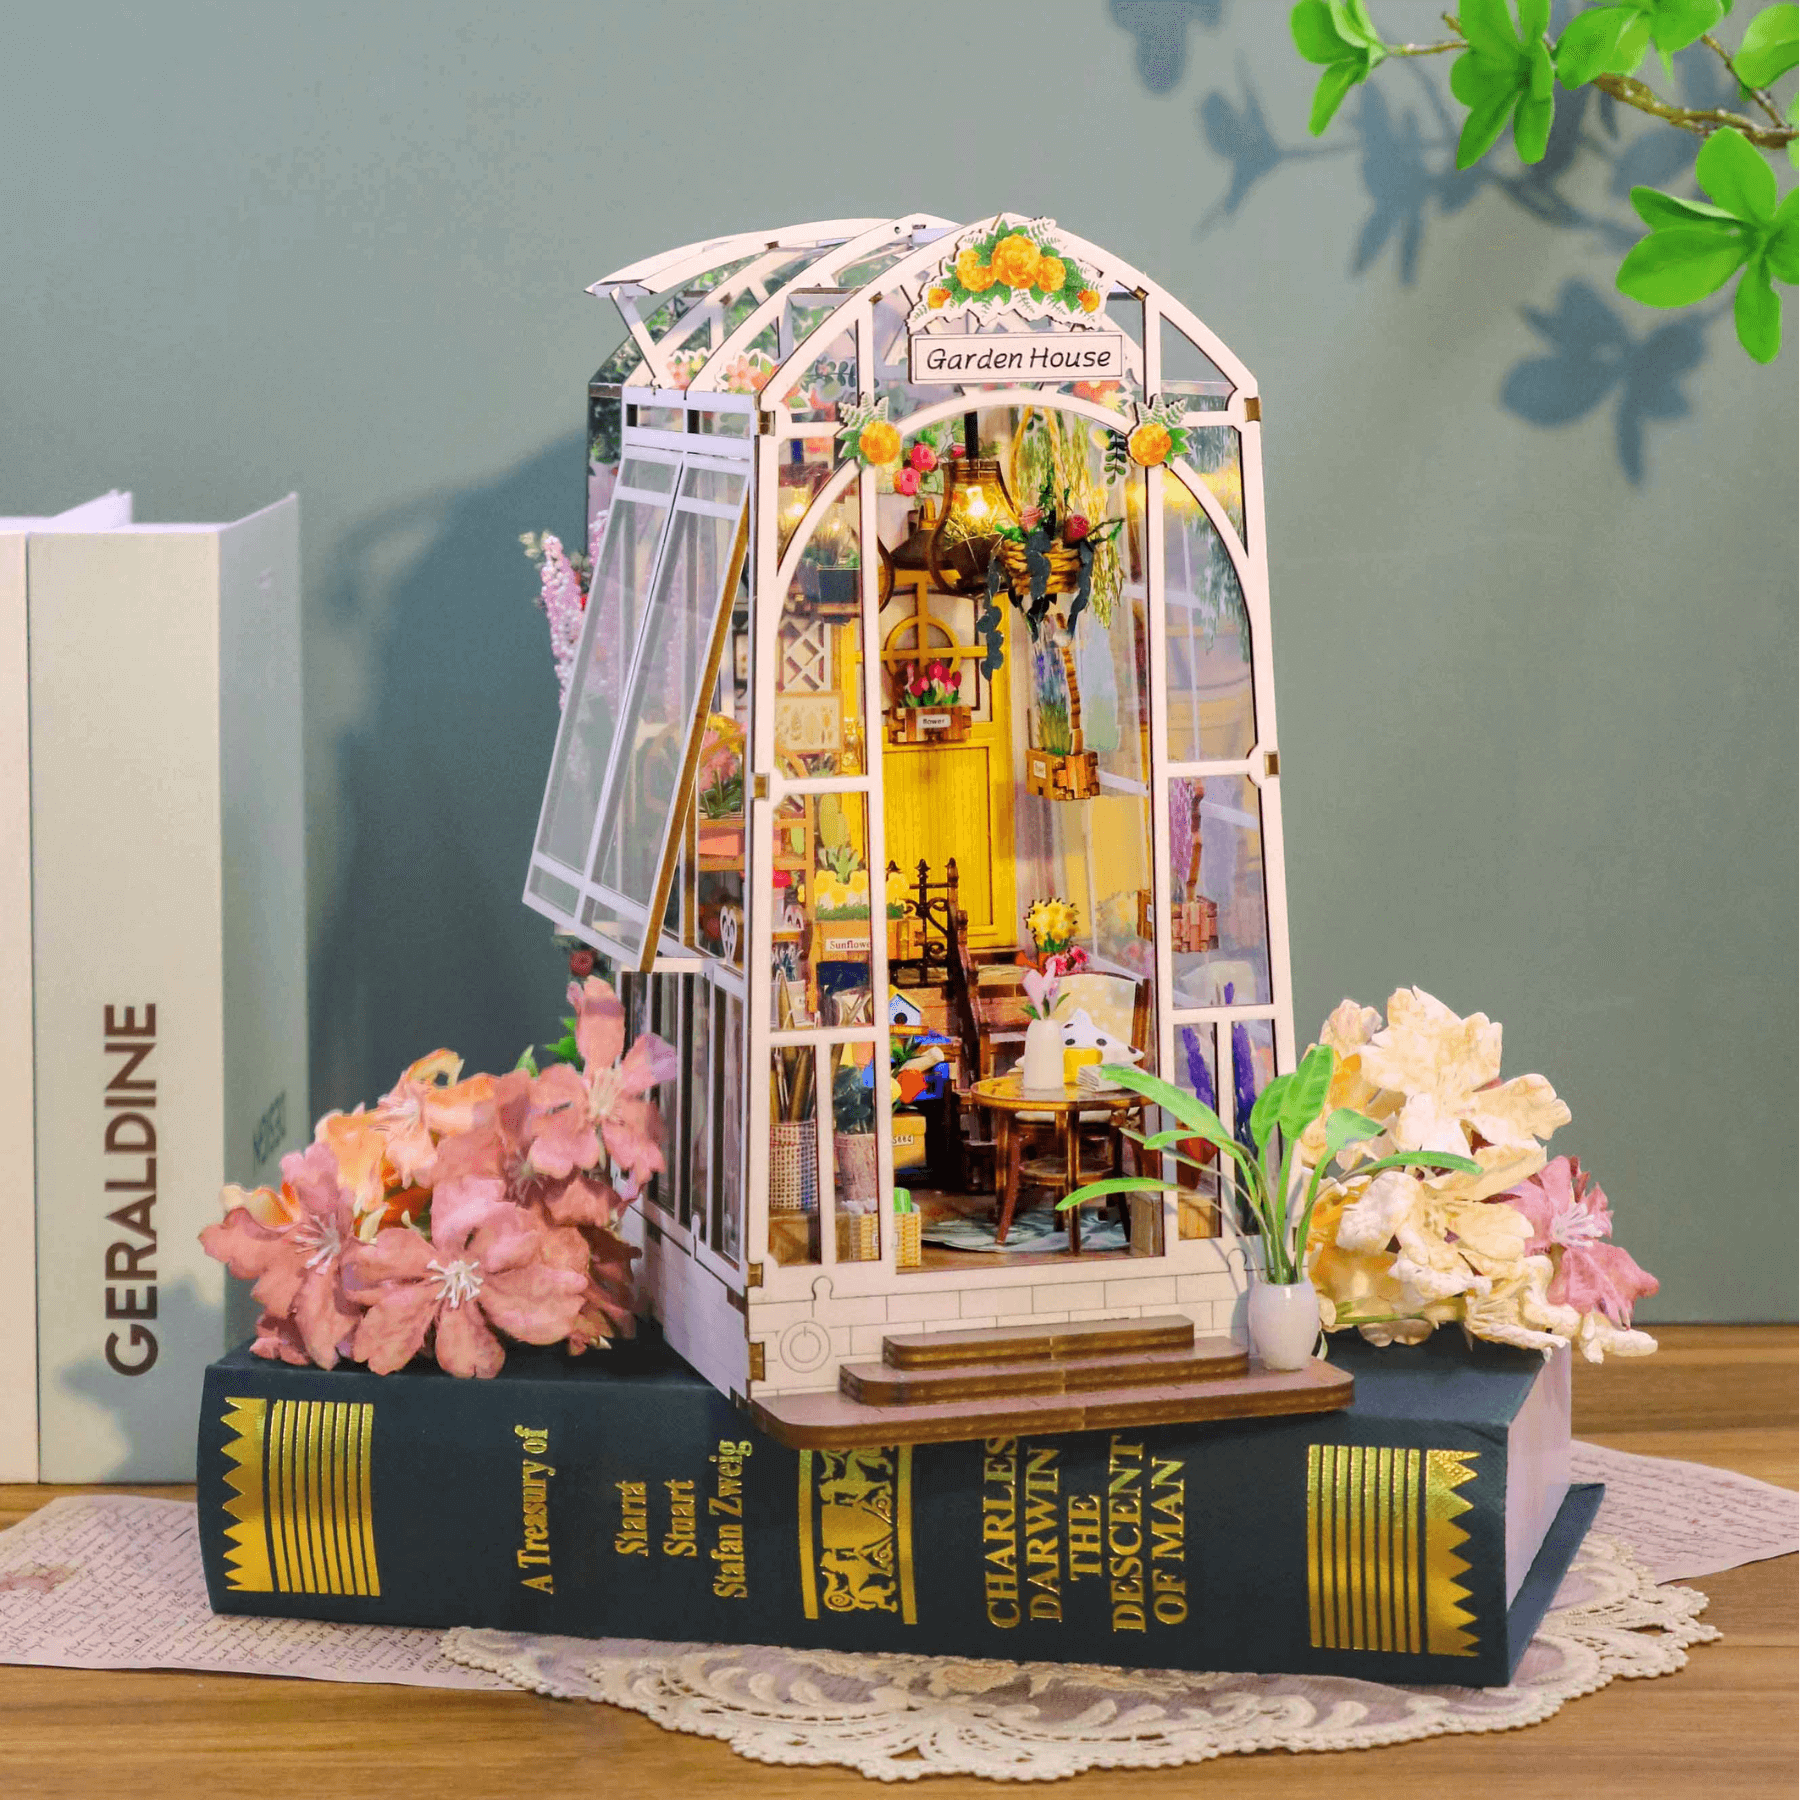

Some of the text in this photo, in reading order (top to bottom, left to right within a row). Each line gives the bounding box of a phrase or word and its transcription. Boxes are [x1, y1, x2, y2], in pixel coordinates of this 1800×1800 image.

[926, 346, 1111, 370] Garden House
[104, 1003, 158, 1377] GERALDINE
[514, 1424, 556, 1595] A Treasury of
[663, 1479, 697, 1557] Stuart
[708, 1440, 752, 1599] Stafan Zweig
[983, 1436, 1021, 1629] CHARLES
[1025, 1446, 1063, 1623] DARWIN
[1068, 1494, 1102, 1581] THE
[1108, 1435, 1147, 1633] DESCENT
[1151, 1456, 1188, 1625] OF MAN
